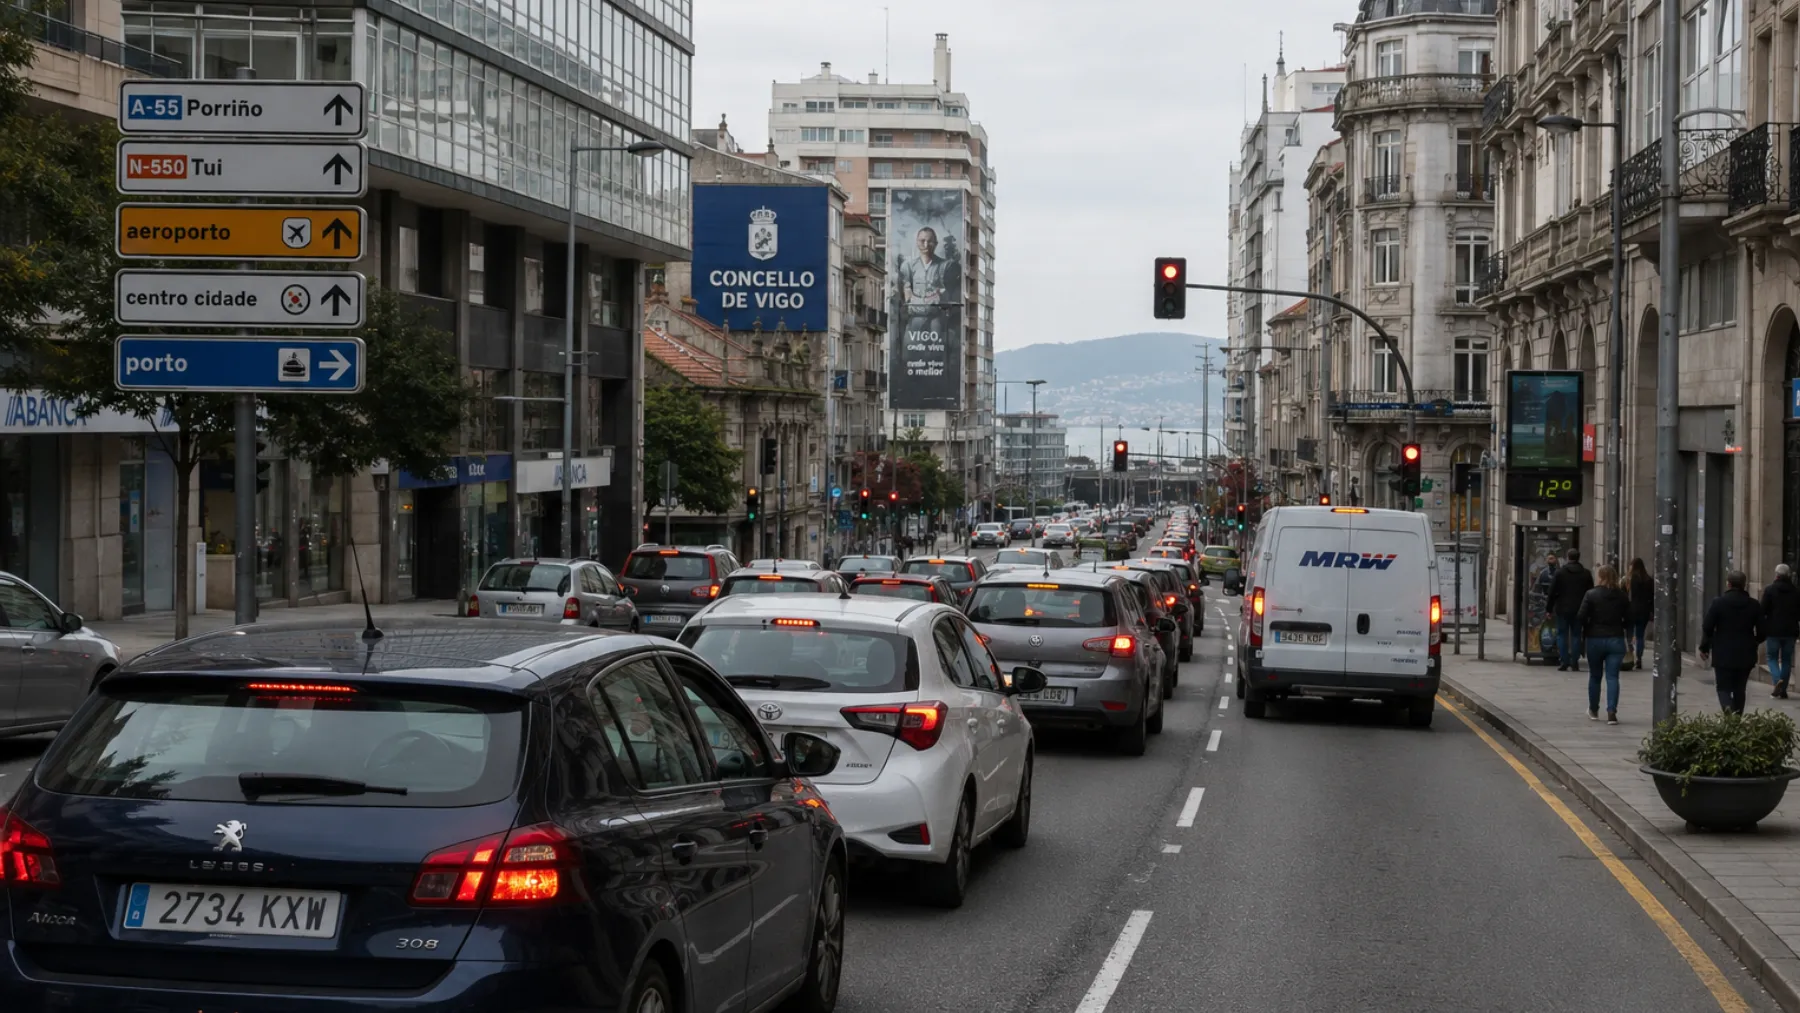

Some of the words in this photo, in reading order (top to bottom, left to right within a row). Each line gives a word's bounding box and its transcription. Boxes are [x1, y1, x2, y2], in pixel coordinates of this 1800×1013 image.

[131, 99, 179, 115] A-55
[187, 99, 262, 117] Porriño
[129, 159, 185, 175] N-550
[191, 158, 222, 176] Tui
[126, 223, 231, 243] aeroporto
[709, 270, 815, 287] CONCELLO
[126, 290, 188, 306] centro
[194, 290, 258, 307] cidade
[722, 292, 748, 308] DE
[755, 292, 804, 309] VIGO
[908, 330, 942, 343] VIGO,
[126, 353, 188, 375] porto
[1299, 550, 1397, 570] MRW
[159, 890, 245, 927] 2734
[258, 894, 327, 931] KXW
[395, 938, 439, 949] 308
